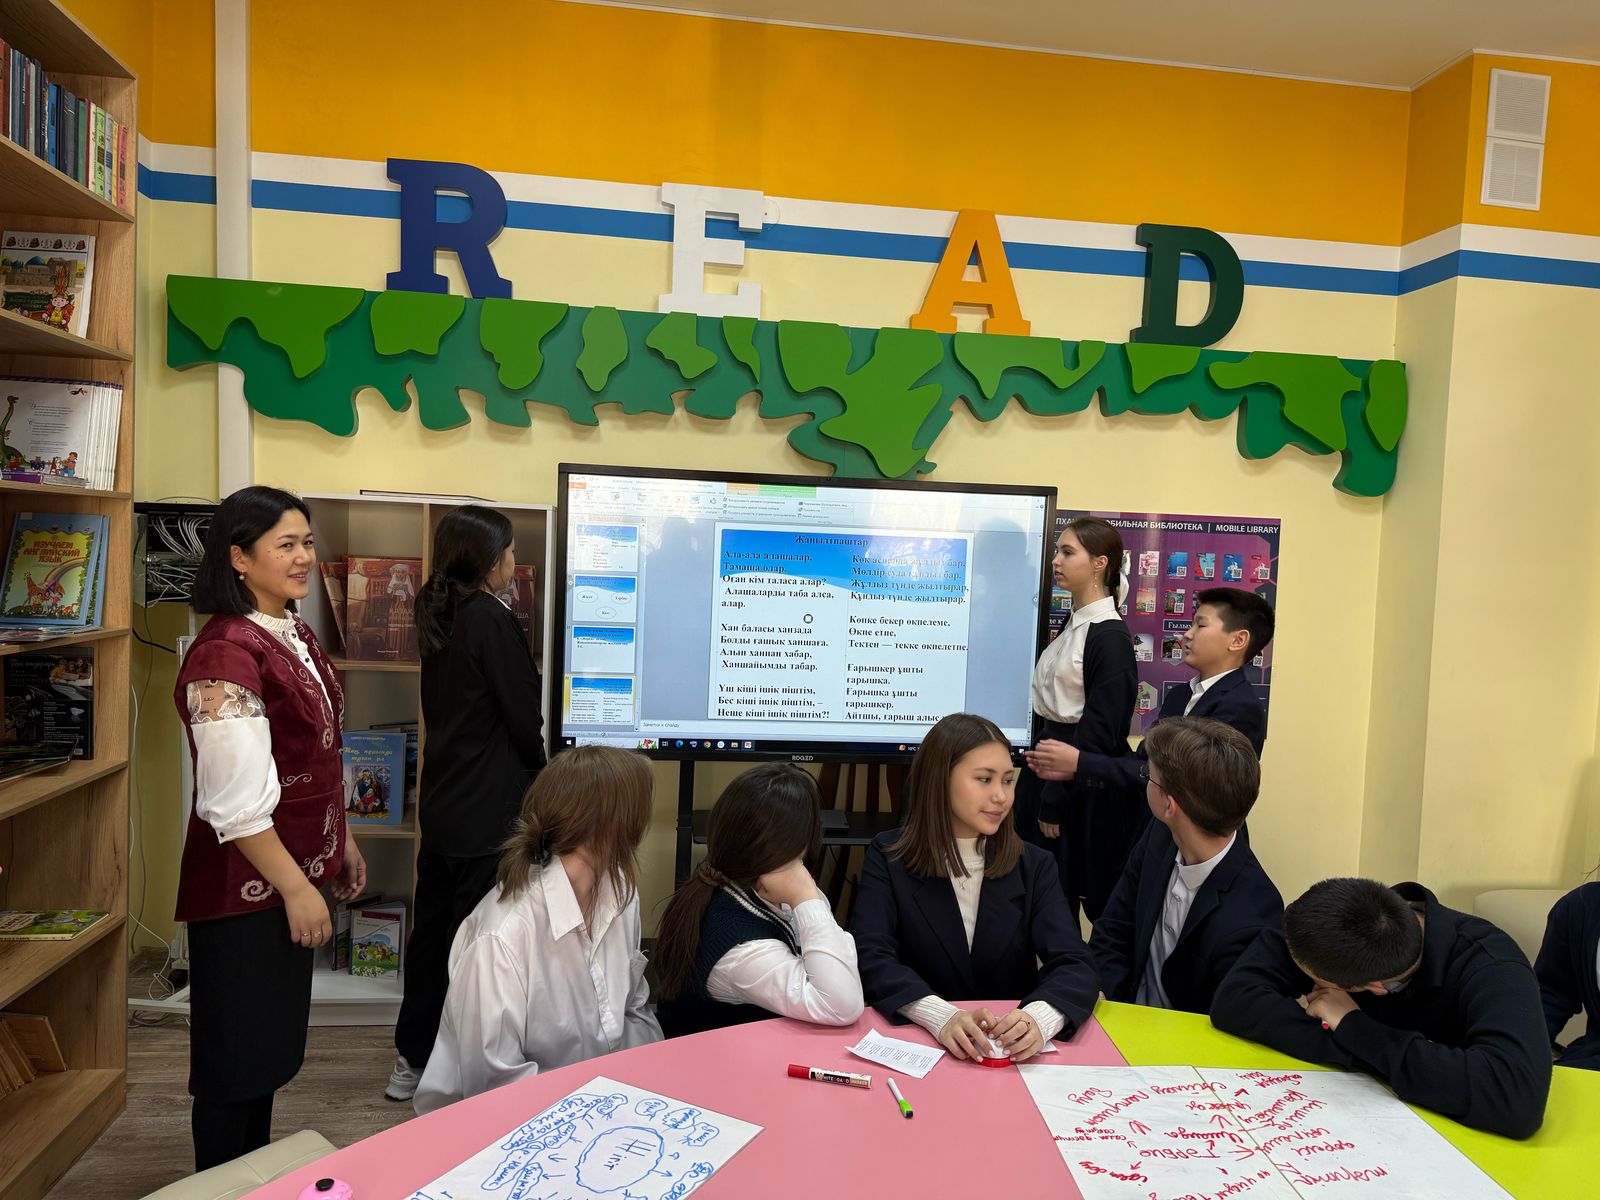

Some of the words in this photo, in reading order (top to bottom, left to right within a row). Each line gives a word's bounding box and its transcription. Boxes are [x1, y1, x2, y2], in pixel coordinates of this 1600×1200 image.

[1150, 520, 1203, 531] БИБЛИОТЕКА
[1215, 525, 1245, 533] MOBILE
[1246, 525, 1279, 534] LIBRARY
[33, 540, 74, 549] ИЗУЧАЕМ
[23, 547, 80, 556] АНГЛИЙСКИЙ
[723, 550, 761, 559] Ала-ала
[38, 555, 63, 563] ЯЗЫК
[723, 562, 760, 572] Тамаша
[748, 575, 764, 584] кім
[799, 578, 827, 587] алар?
[724, 587, 786, 598] Алашаларды
[788, 589, 809, 598] таба
[721, 600, 746, 609] алар.
[879, 617, 905, 627] бекер
[720, 623, 739, 632] Хан
[741, 623, 775, 633] баласы
[777, 626, 812, 634] ханзада
[720, 635, 751, 645] Болды
[848, 639, 880, 649] Тектен
[895, 642, 919, 650] текке
[719, 648, 747, 657] Алып
[722, 659, 787, 670] Ханшайымды
[790, 662, 818, 672] табар.
[736, 684, 757, 693] кіші
[759, 685, 780, 694] ішік
[718, 696, 734, 705] Бес
[736, 696, 757, 706] кіші
[759, 697, 779, 706] ішік
[717, 708, 743, 717] Неше
[745, 708, 766, 718] кіші
[768, 709, 788, 718] ішік
[790, 710, 830, 719] піштім?!
[916, 714, 940, 722] алыс
